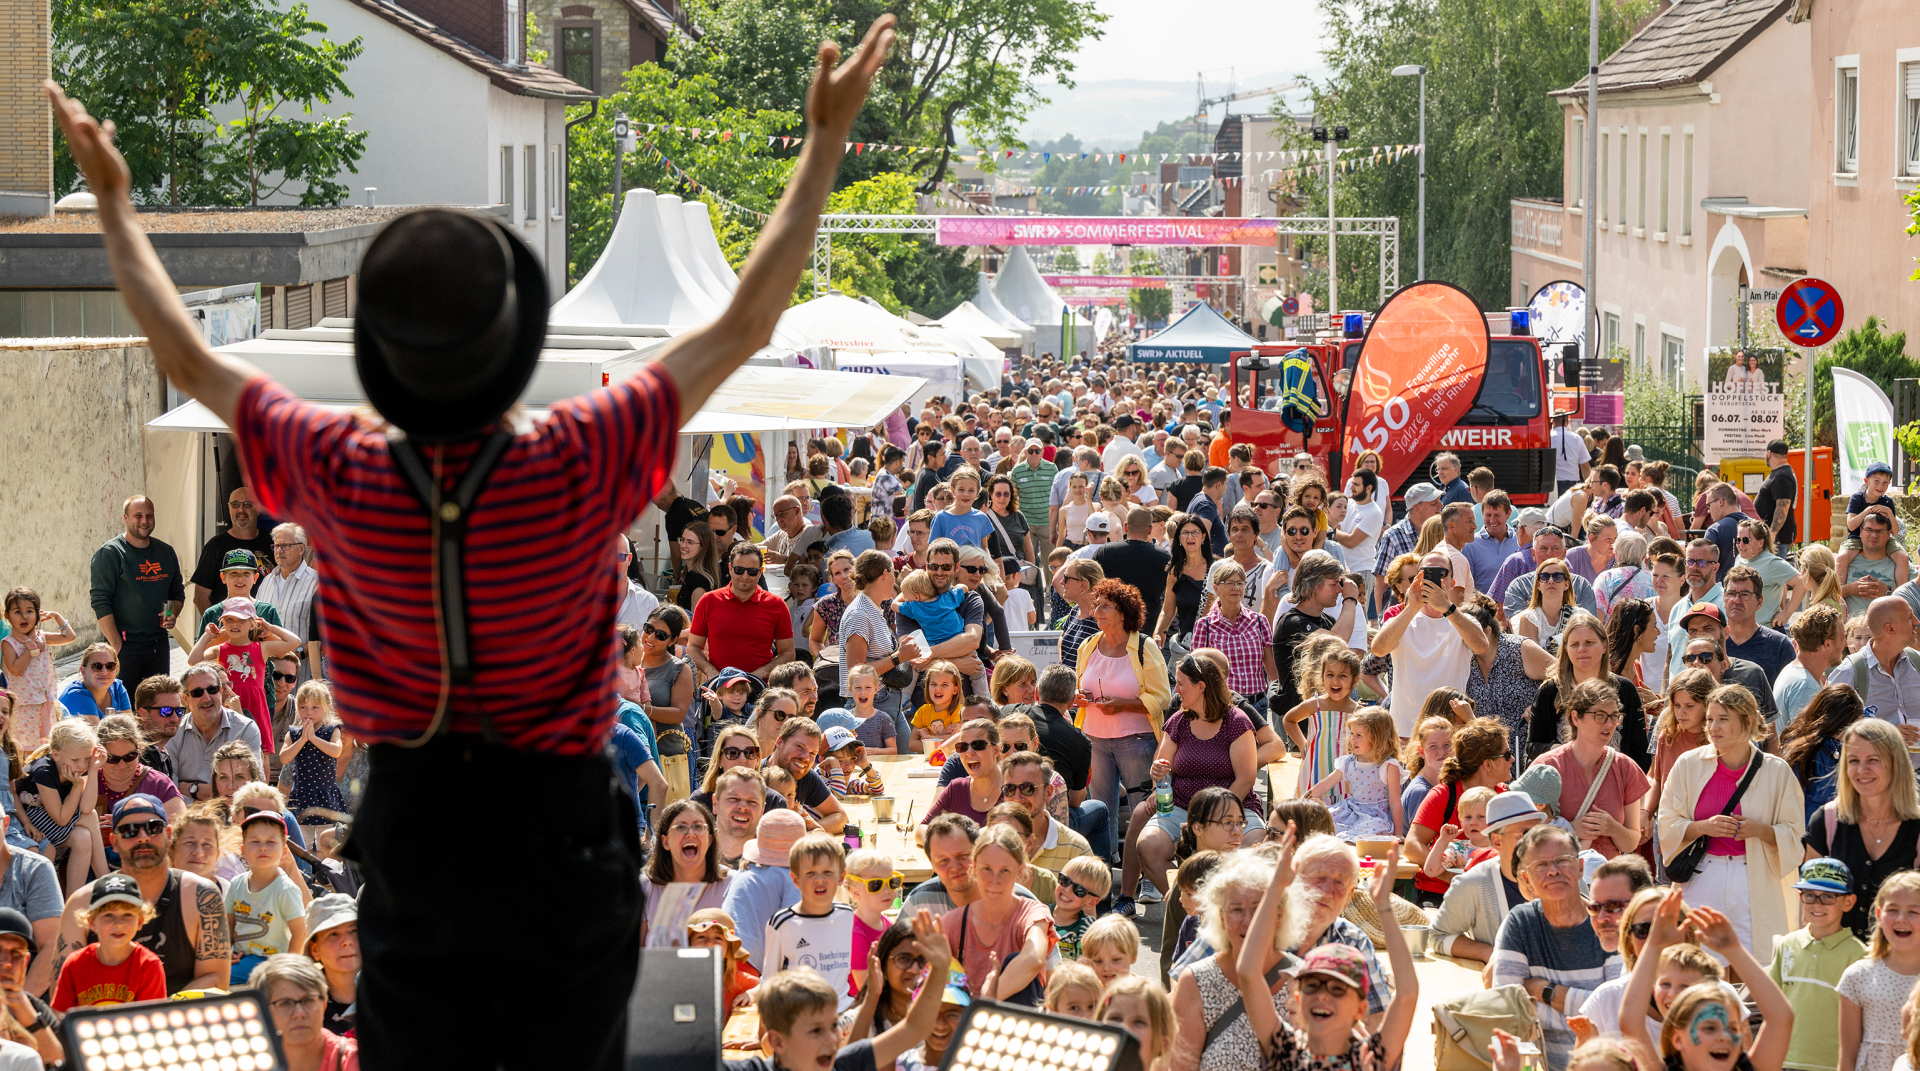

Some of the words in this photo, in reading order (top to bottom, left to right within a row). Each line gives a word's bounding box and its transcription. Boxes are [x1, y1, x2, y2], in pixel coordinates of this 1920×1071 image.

[1014, 225, 1046, 238] SWR
[1066, 224, 1204, 238] SOMMERFESTIVAL
[1750, 291, 1761, 300] Am
[1764, 291, 1780, 300] Pfal
[1137, 350, 1155, 358] SWR
[1165, 350, 1203, 359] AKTUELL
[1406, 343, 1450, 390] Freiwillige
[1413, 347, 1460, 398] Feuerwehr
[1423, 363, 1466, 409] Ingelheim
[1712, 381, 1779, 394] HOFFEST
[1433, 400, 1447, 417] am
[1446, 372, 1473, 400] Rhein
[1712, 394, 1779, 402] DOPPELSTÜCK
[1711, 414, 1740, 422] 06.07.
[1751, 415, 1778, 423] 08.07.
